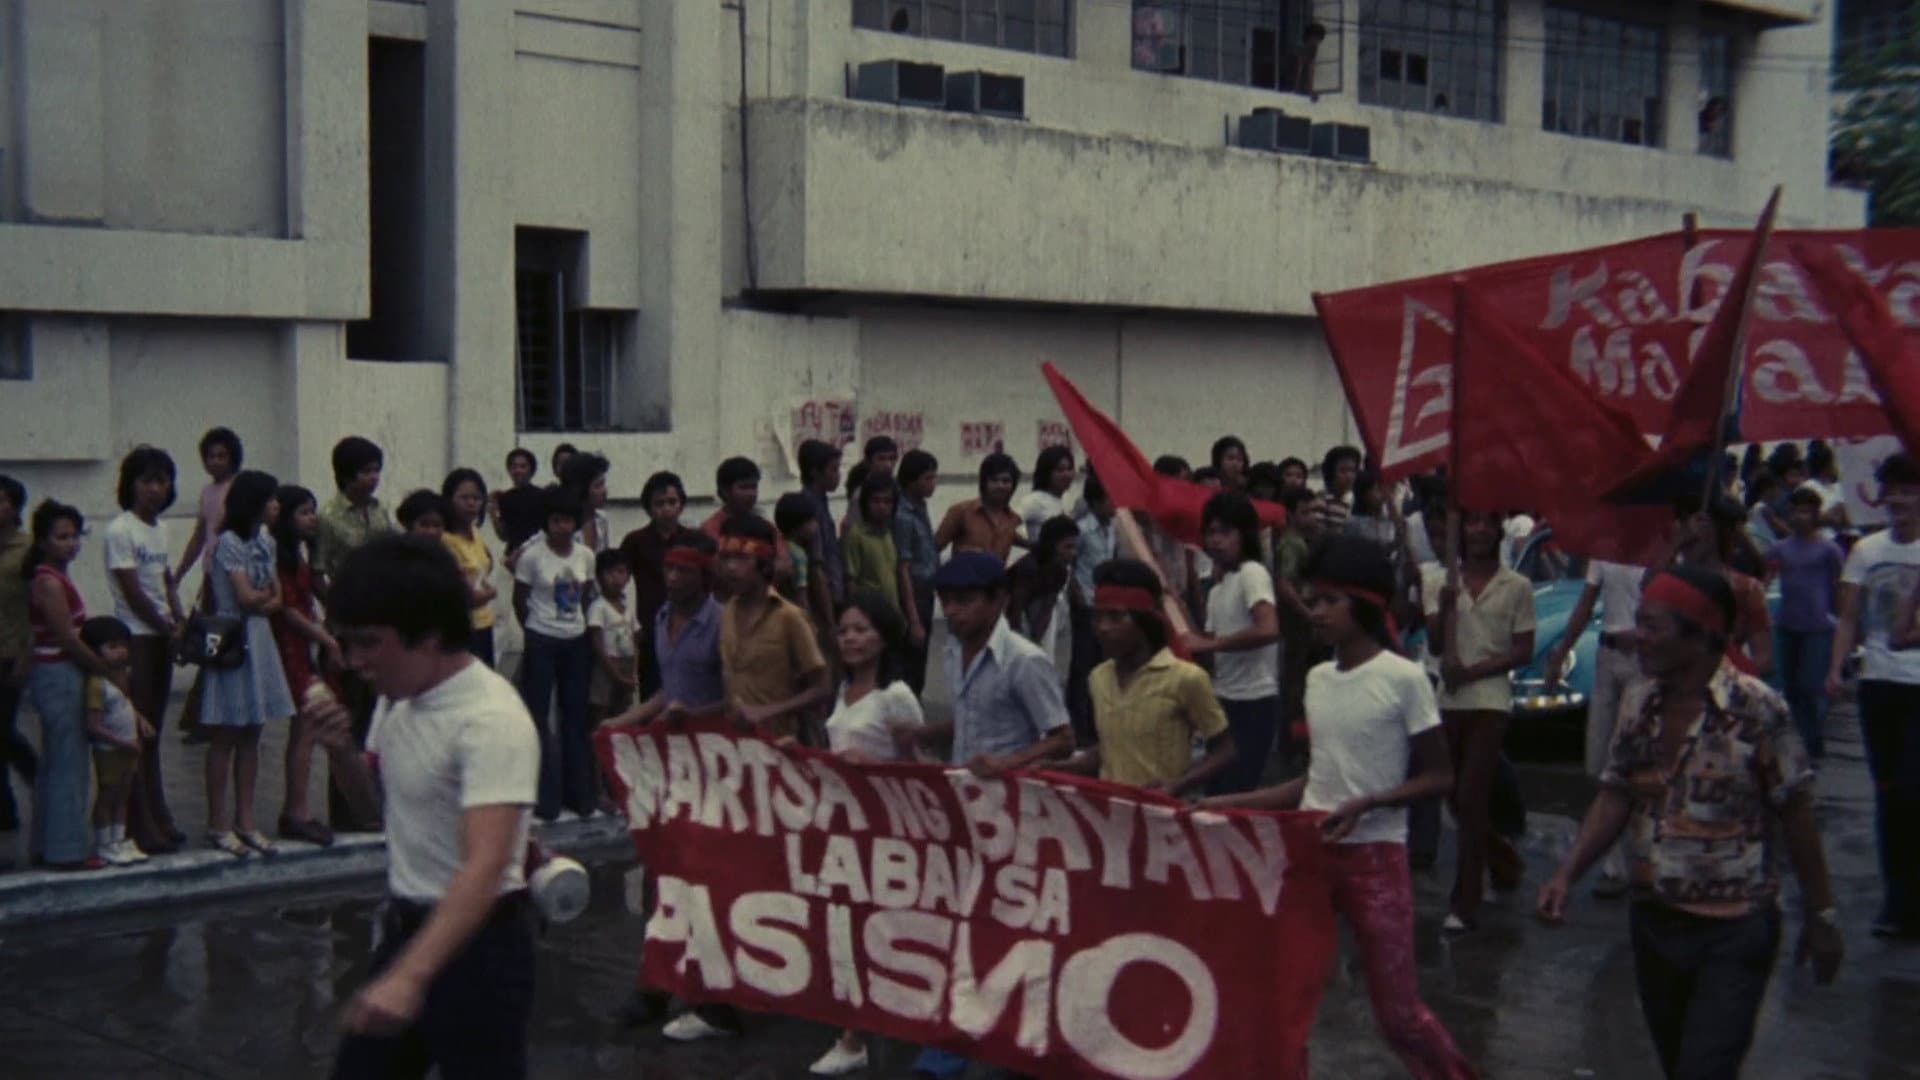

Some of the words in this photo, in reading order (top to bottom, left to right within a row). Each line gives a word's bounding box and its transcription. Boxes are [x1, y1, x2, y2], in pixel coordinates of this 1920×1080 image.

[610, 732, 869, 836] MARTSA
[867, 775, 952, 841] NG
[944, 768, 1289, 917] BAYAN
[991, 863, 1071, 936] SA
[645, 874, 1218, 1079] PASISMO
